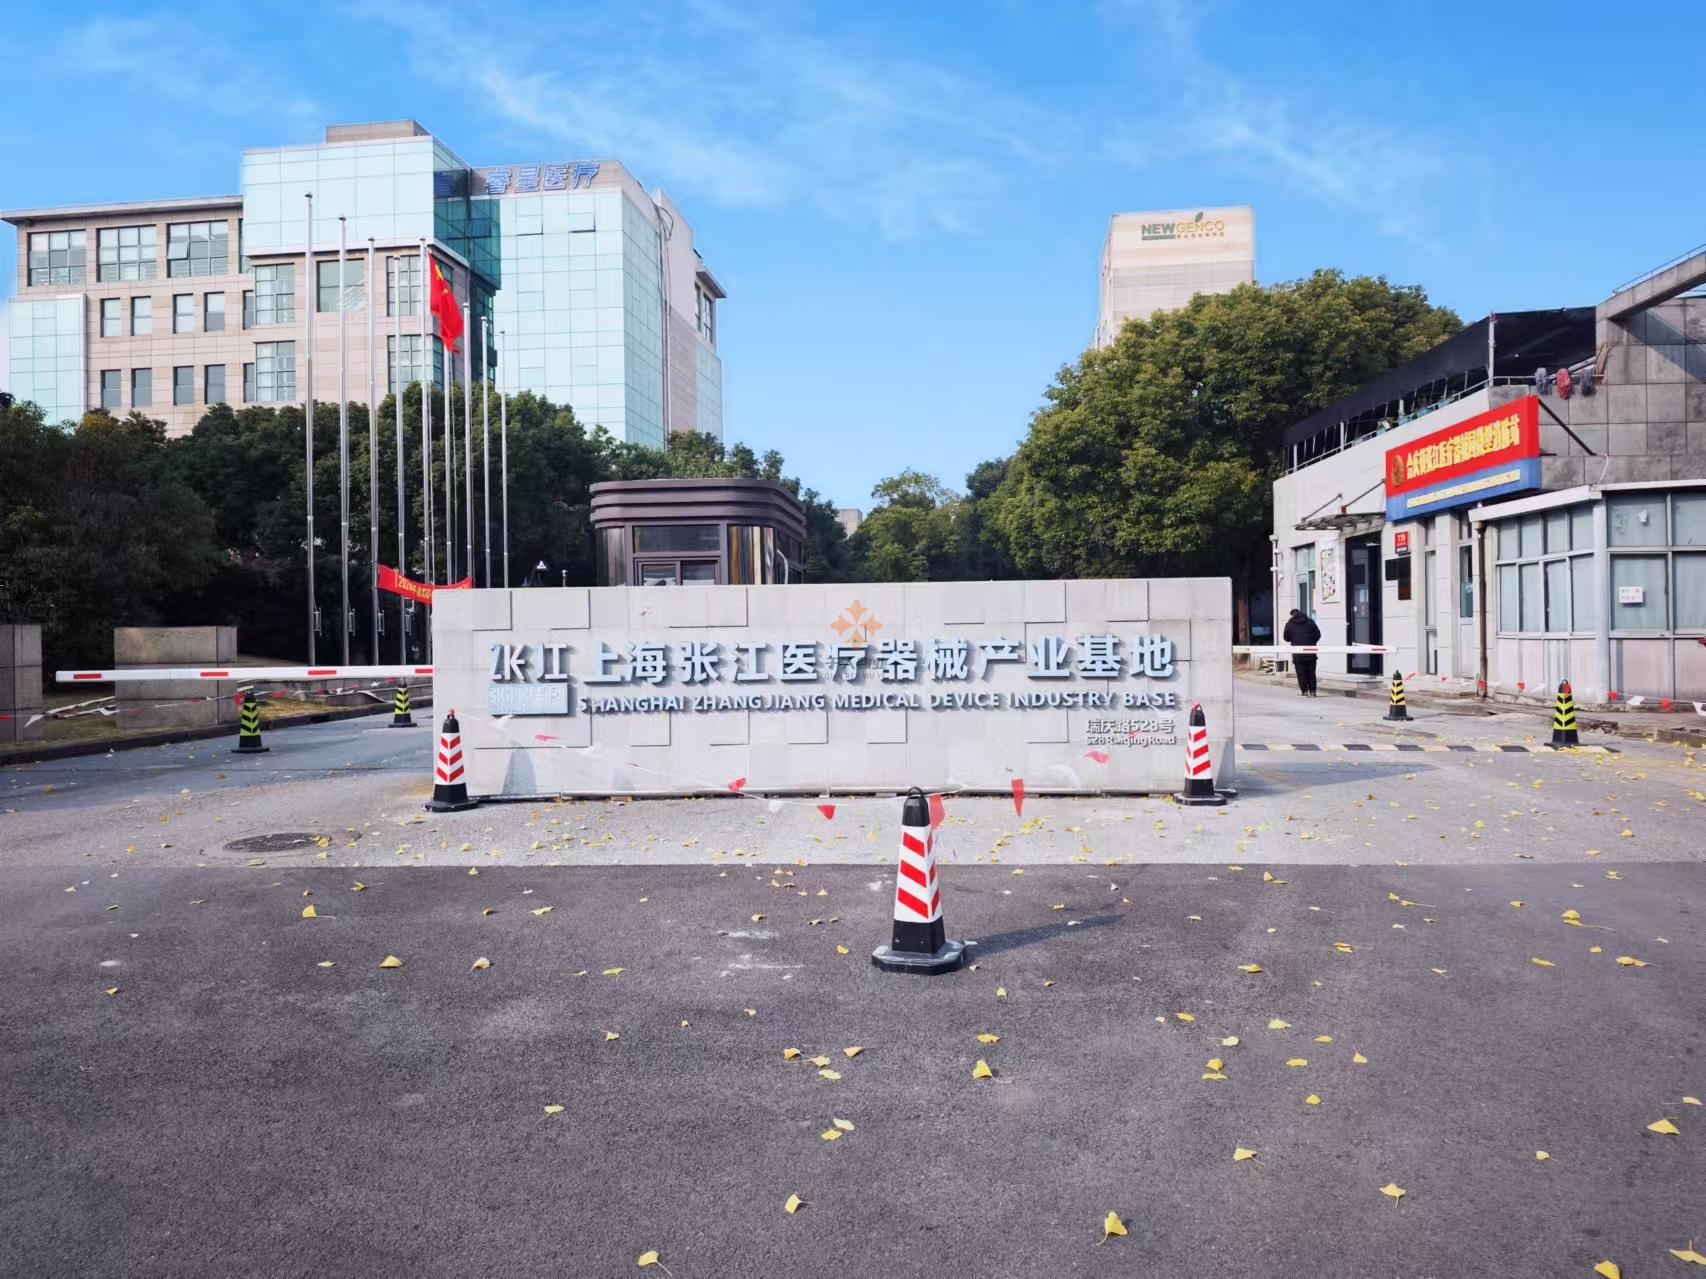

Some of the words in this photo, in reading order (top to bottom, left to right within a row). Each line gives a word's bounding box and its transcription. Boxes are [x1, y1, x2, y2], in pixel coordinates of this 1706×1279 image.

[484, 162, 599, 194] 睿星医疗
[584, 635, 1175, 685] 上海张江医疗器械产业基地
[578, 694, 685, 713] SHANGHAI
[692, 693, 826, 712] ZHANGJIANG
[832, 692, 920, 710] MEDICAL
[930, 691, 1000, 709] DEVICE
[1008, 690, 1113, 708] INDUSTRY
[1123, 690, 1176, 708] BASE
